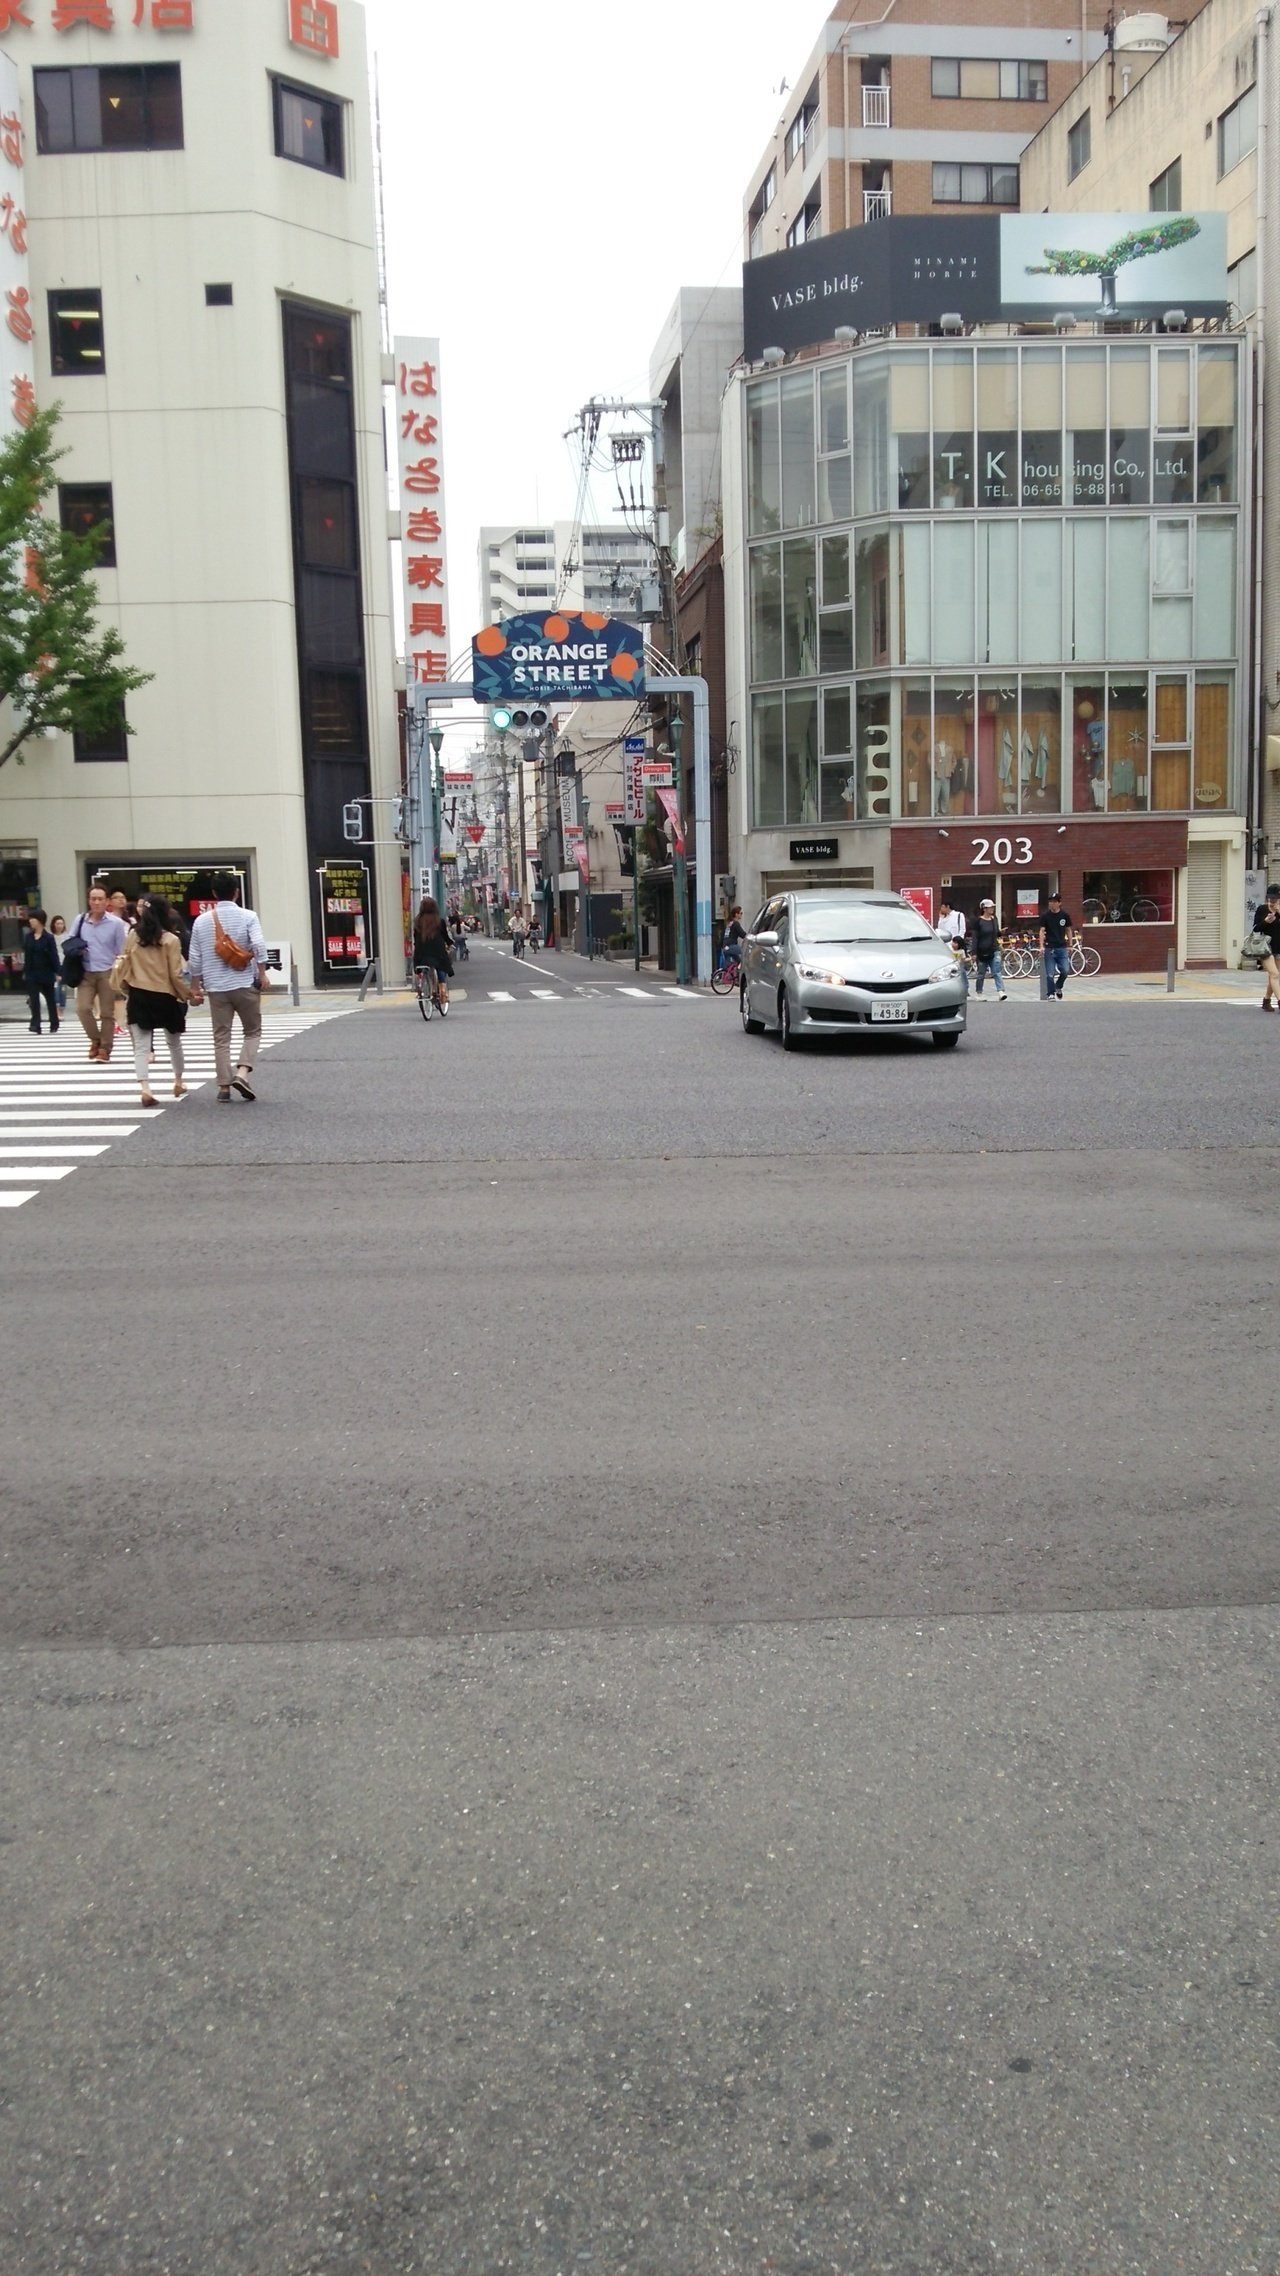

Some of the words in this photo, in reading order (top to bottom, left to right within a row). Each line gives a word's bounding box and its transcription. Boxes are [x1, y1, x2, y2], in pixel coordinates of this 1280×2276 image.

[771, 284, 816, 311] VASE
[823, 274, 864, 297] bldg.
[941, 452, 970, 480] T.
[987, 451, 1007, 479] K
[1114, 459, 1145, 477] Co.,
[1155, 458, 1187, 475] Ltd.
[985, 485, 1014, 496] TEL.
[1023, 483, 1125, 496] 06-655-8811
[400, 361, 447, 683] はなさき家具店
[511, 644, 608, 661] ORANGE
[514, 664, 608, 682] STREET
[633, 756, 644, 819] アサヒビール
[561, 777, 571, 822] MUSEUM
[795, 846, 815, 854] VASE
[971, 837, 1033, 865] 203
[327, 898, 352, 912] SALE
[328, 941, 343, 952] SALE
[346, 941, 361, 952] SALE
